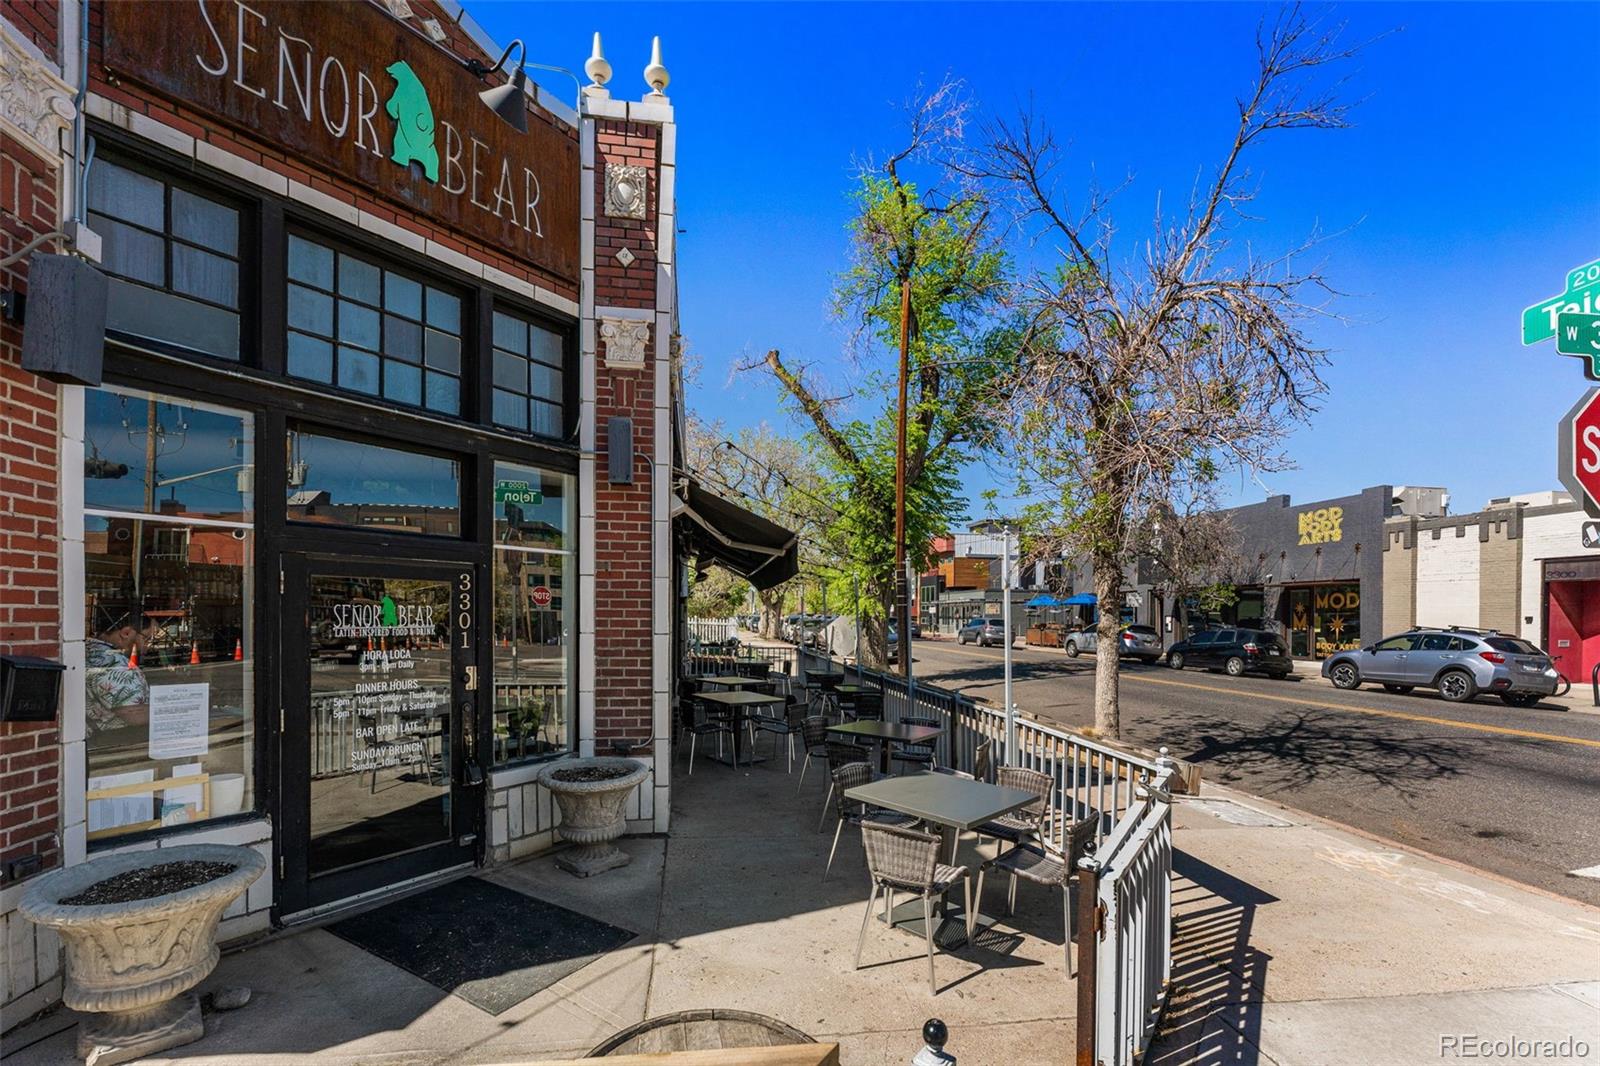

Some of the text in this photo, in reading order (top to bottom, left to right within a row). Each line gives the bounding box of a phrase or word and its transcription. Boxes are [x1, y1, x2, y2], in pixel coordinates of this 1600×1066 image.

[196, 0, 544, 238] SEÑOR BEAR
[1566, 326, 1578, 341] W
[1298, 507, 1344, 524] MOD
[1297, 529, 1343, 545] ARTS
[1316, 592, 1360, 609] MOD
[333, 604, 434, 627] SEÑOR BEAR
[459, 574, 471, 649] 3301
[391, 628, 409, 636] FOOD
[416, 627, 436, 635] DRINK
[363, 649, 411, 660] HORA LOCA
[398, 660, 415, 669] Daily
[355, 680, 418, 693] DINNER HOURS
[333, 698, 350, 707] 5pm
[358, 696, 377, 705] 10pm
[378, 693, 403, 702] Sunday
[409, 691, 436, 700] Thursday
[333, 710, 350, 719] 5pm
[358, 708, 377, 717] 11pm
[380, 704, 400, 713] Friday
[409, 701, 437, 711] Saturday
[355, 721, 418, 738] BAR OPEN LATE
[351, 742, 423, 761] SUNDAY BRUNCH
[351, 761, 377, 771] Sunday
